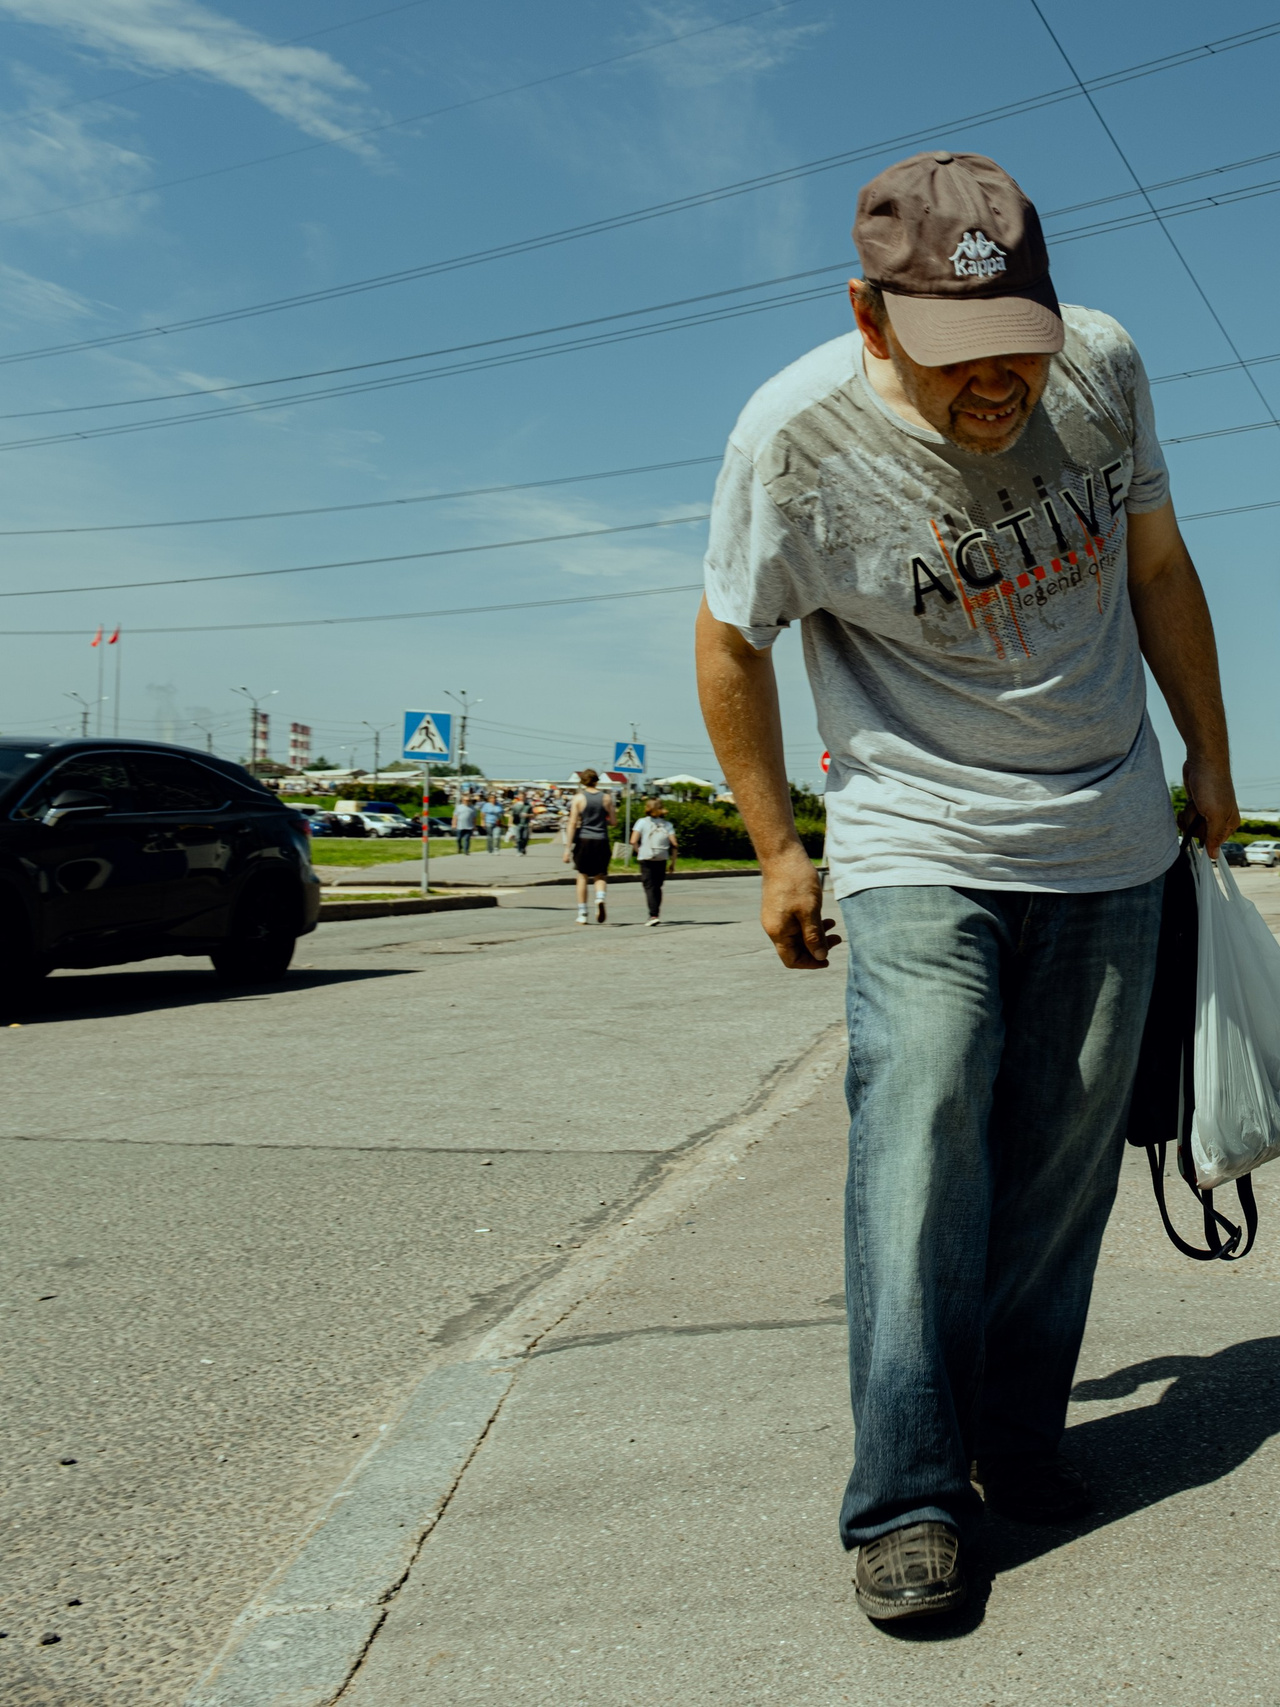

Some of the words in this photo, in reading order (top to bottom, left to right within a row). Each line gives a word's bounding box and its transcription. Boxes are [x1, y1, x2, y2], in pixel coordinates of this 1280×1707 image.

[953, 256, 1007, 278] Kappa
[910, 458, 1123, 616] ACTIVE
[1017, 563, 1082, 610] legend
